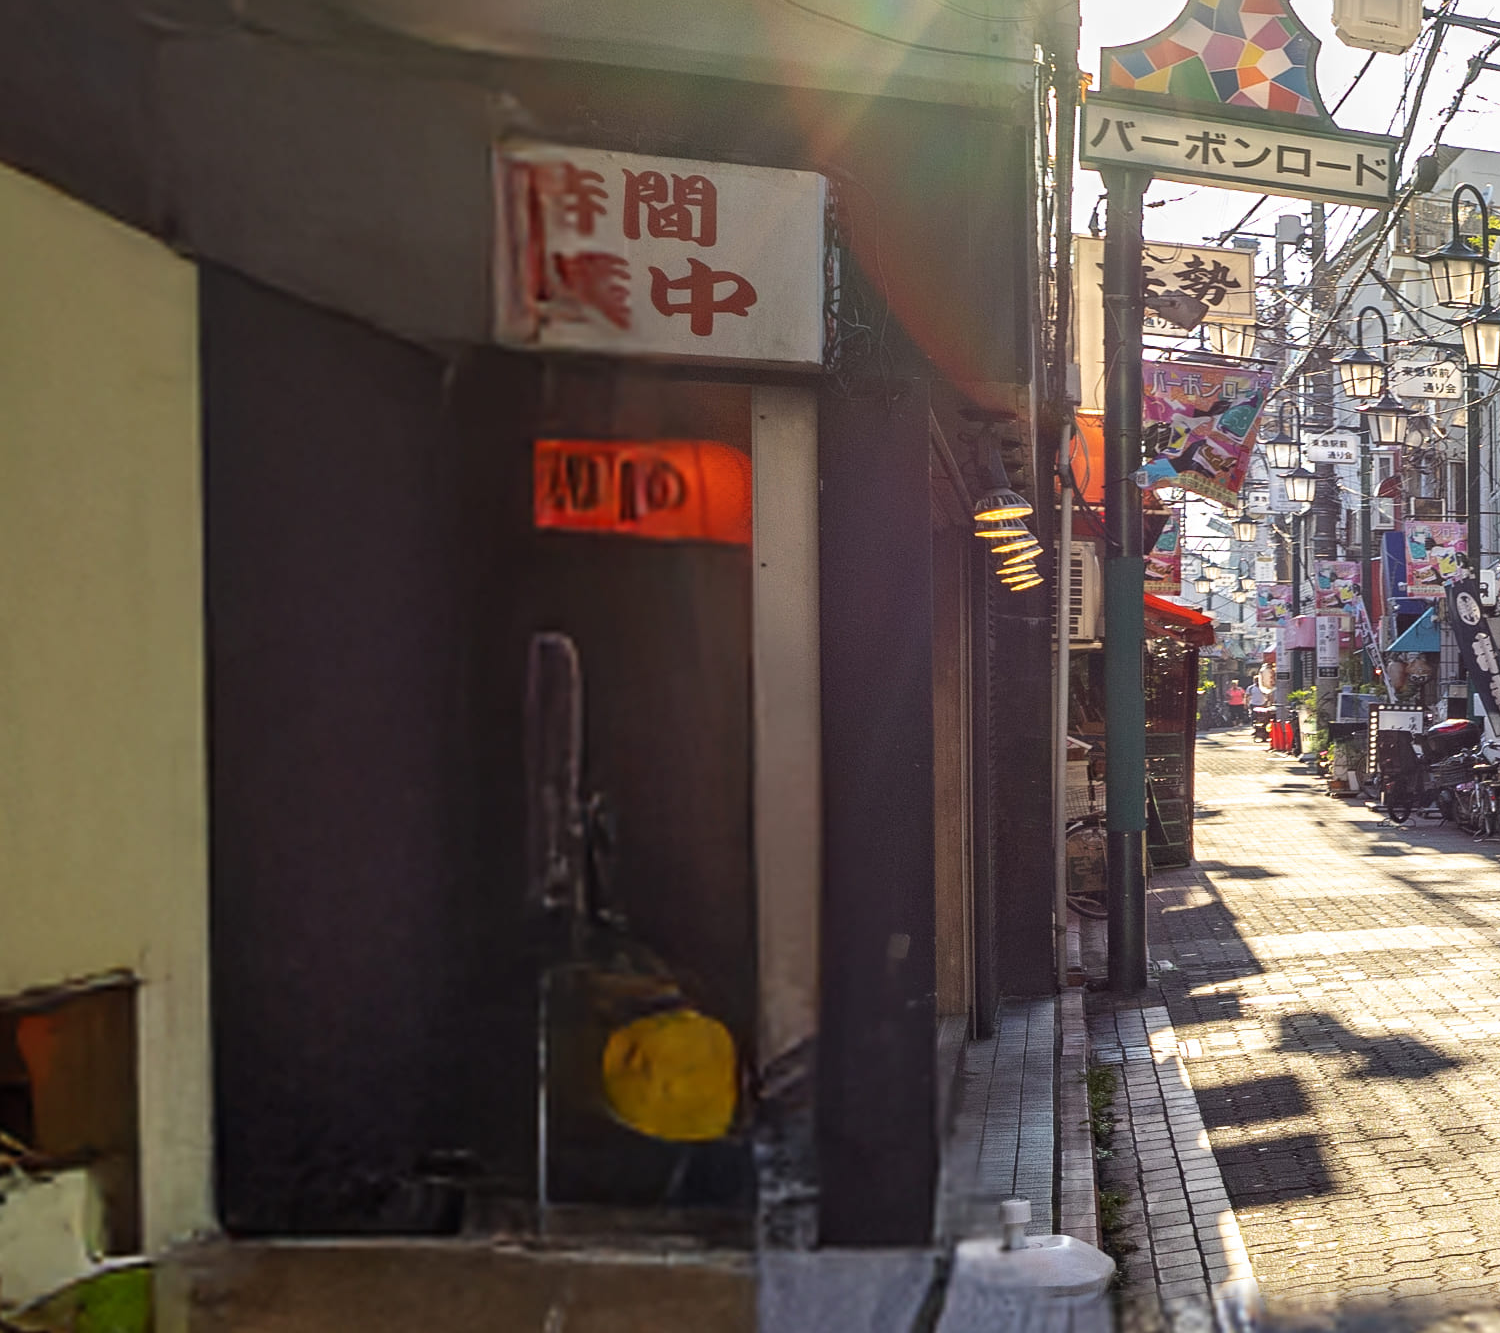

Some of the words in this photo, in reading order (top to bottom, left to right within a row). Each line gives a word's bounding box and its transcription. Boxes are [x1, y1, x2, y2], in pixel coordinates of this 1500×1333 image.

[1089, 116, 1389, 189] バーボンロード
[1423, 382, 1456, 395] 通り会
